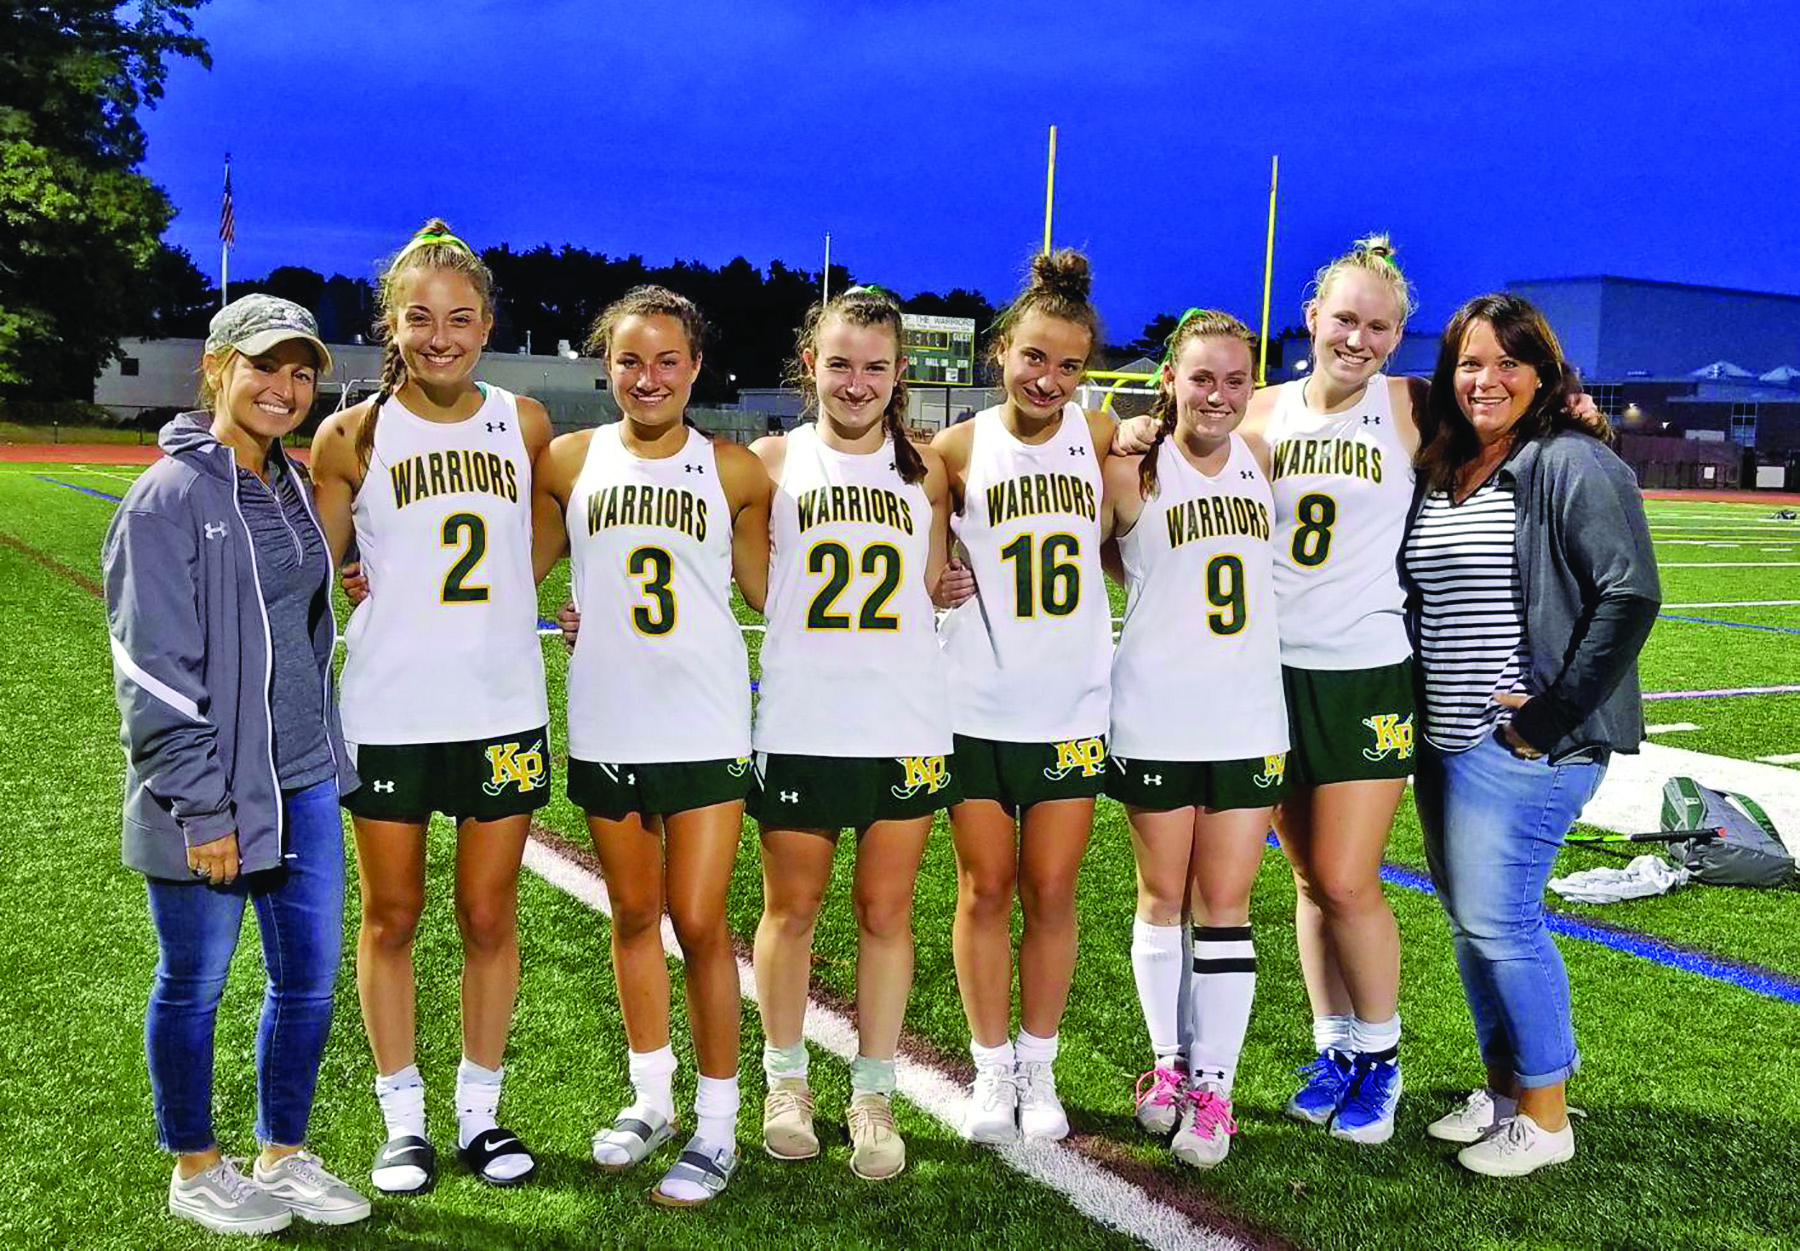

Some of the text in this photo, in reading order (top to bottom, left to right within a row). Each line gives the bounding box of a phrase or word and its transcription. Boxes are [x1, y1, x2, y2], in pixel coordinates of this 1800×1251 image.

[916, 315, 930, 324] THE
[934, 317, 975, 326] WARRIORS
[953, 332, 971, 342] GUEST
[388, 449, 518, 511] WARRIORS
[1271, 437, 1383, 485] WARRIORS
[587, 484, 708, 543] WARRIORS
[797, 485, 914, 537] WARRIORS
[985, 472, 1097, 528] WARRIORS
[1165, 495, 1270, 550] WARRIORS
[1290, 490, 1337, 569] 8
[440, 511, 490, 605] 2
[805, 539, 904, 631] 22
[1000, 530, 1083, 620] 16
[626, 543, 677, 638] 3
[1205, 552, 1249, 637] 9
[1056, 737, 1104, 777] KP
[1370, 713, 1414, 760] KP
[487, 742, 543, 793] KP
